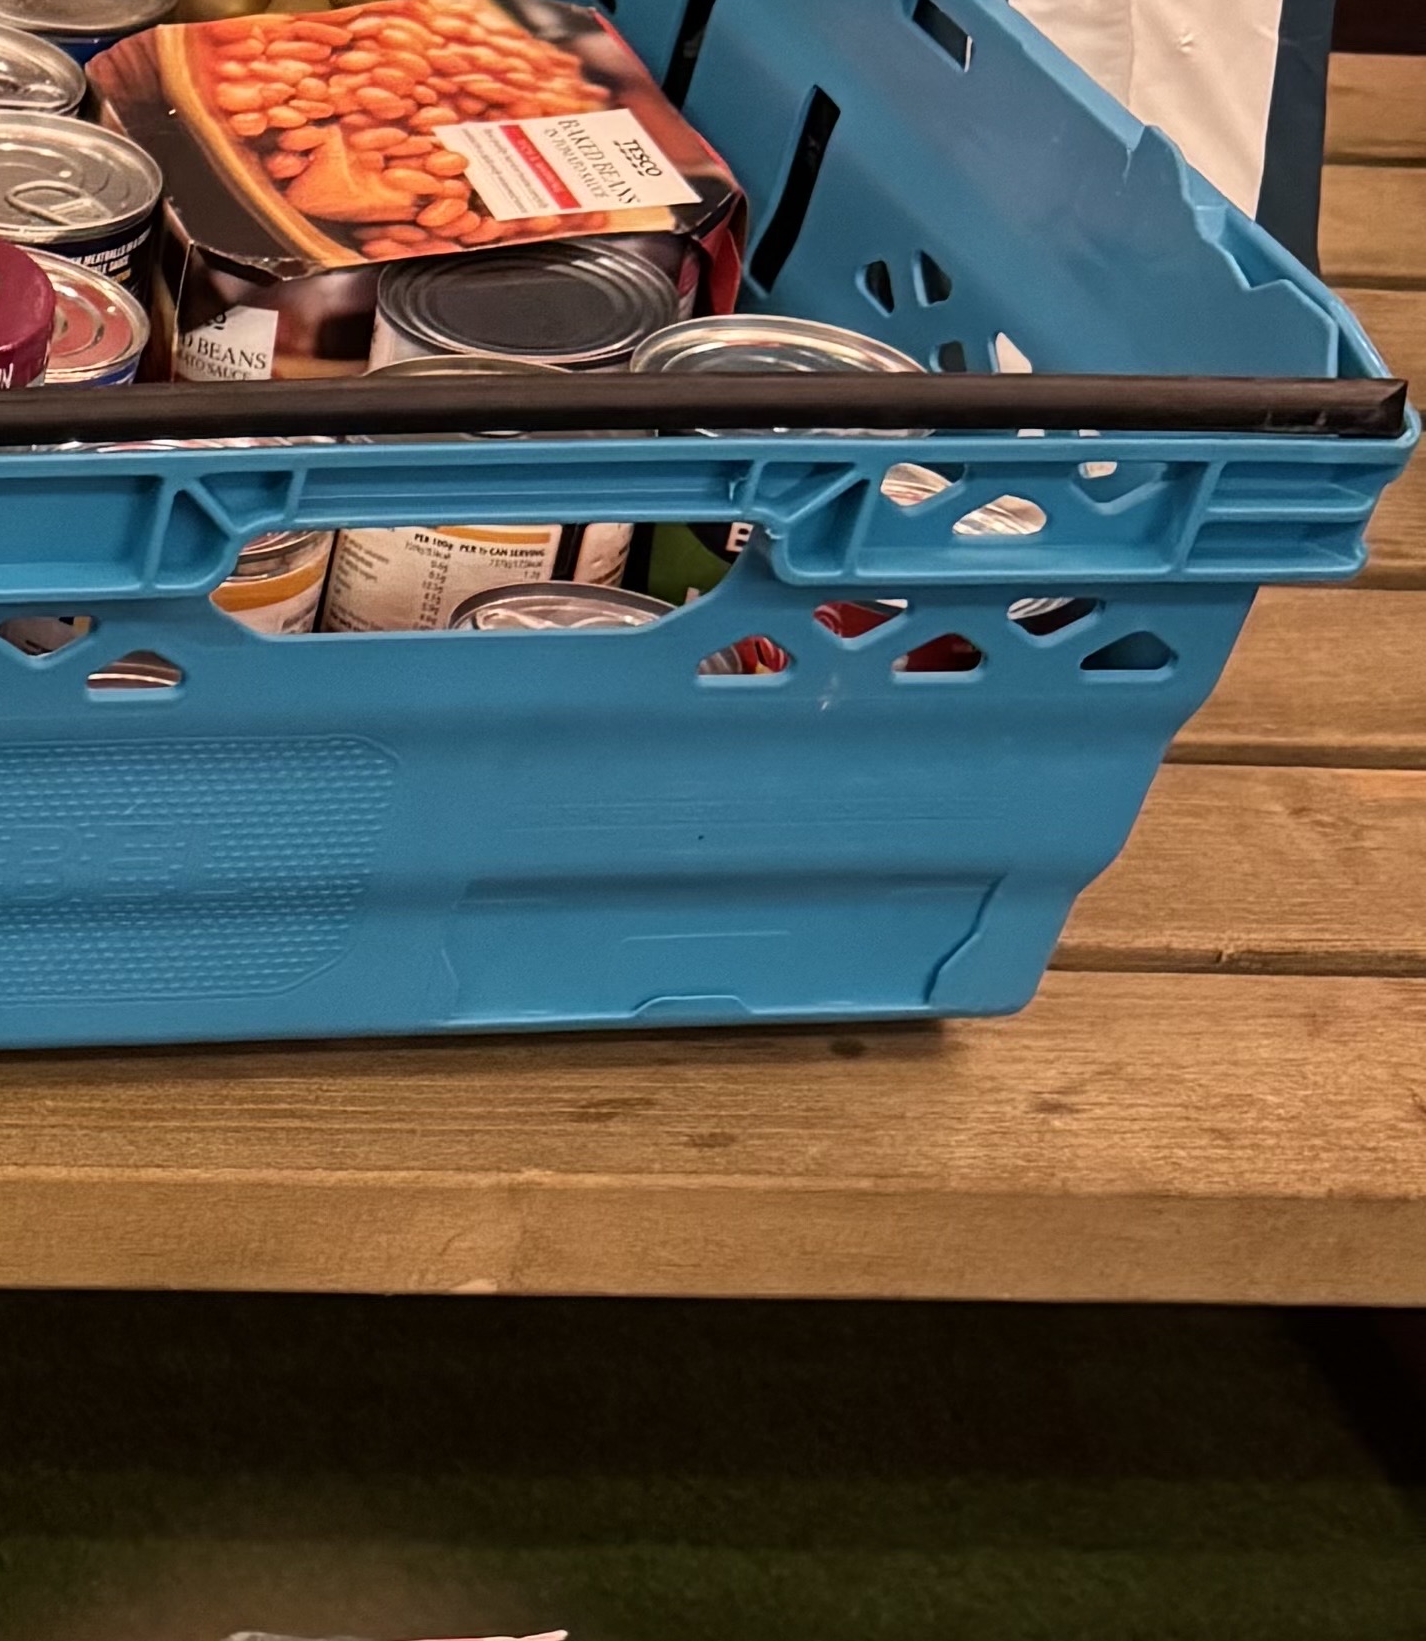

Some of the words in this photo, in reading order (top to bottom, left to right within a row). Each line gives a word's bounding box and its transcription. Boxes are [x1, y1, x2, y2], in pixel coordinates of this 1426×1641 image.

[558, 119, 606, 163] BAKED
[623, 138, 663, 178] TESCO
[197, 336, 267, 370] BEANS
[207, 362, 250, 381] SAUCE
[509, 547, 546, 559] SERVING
